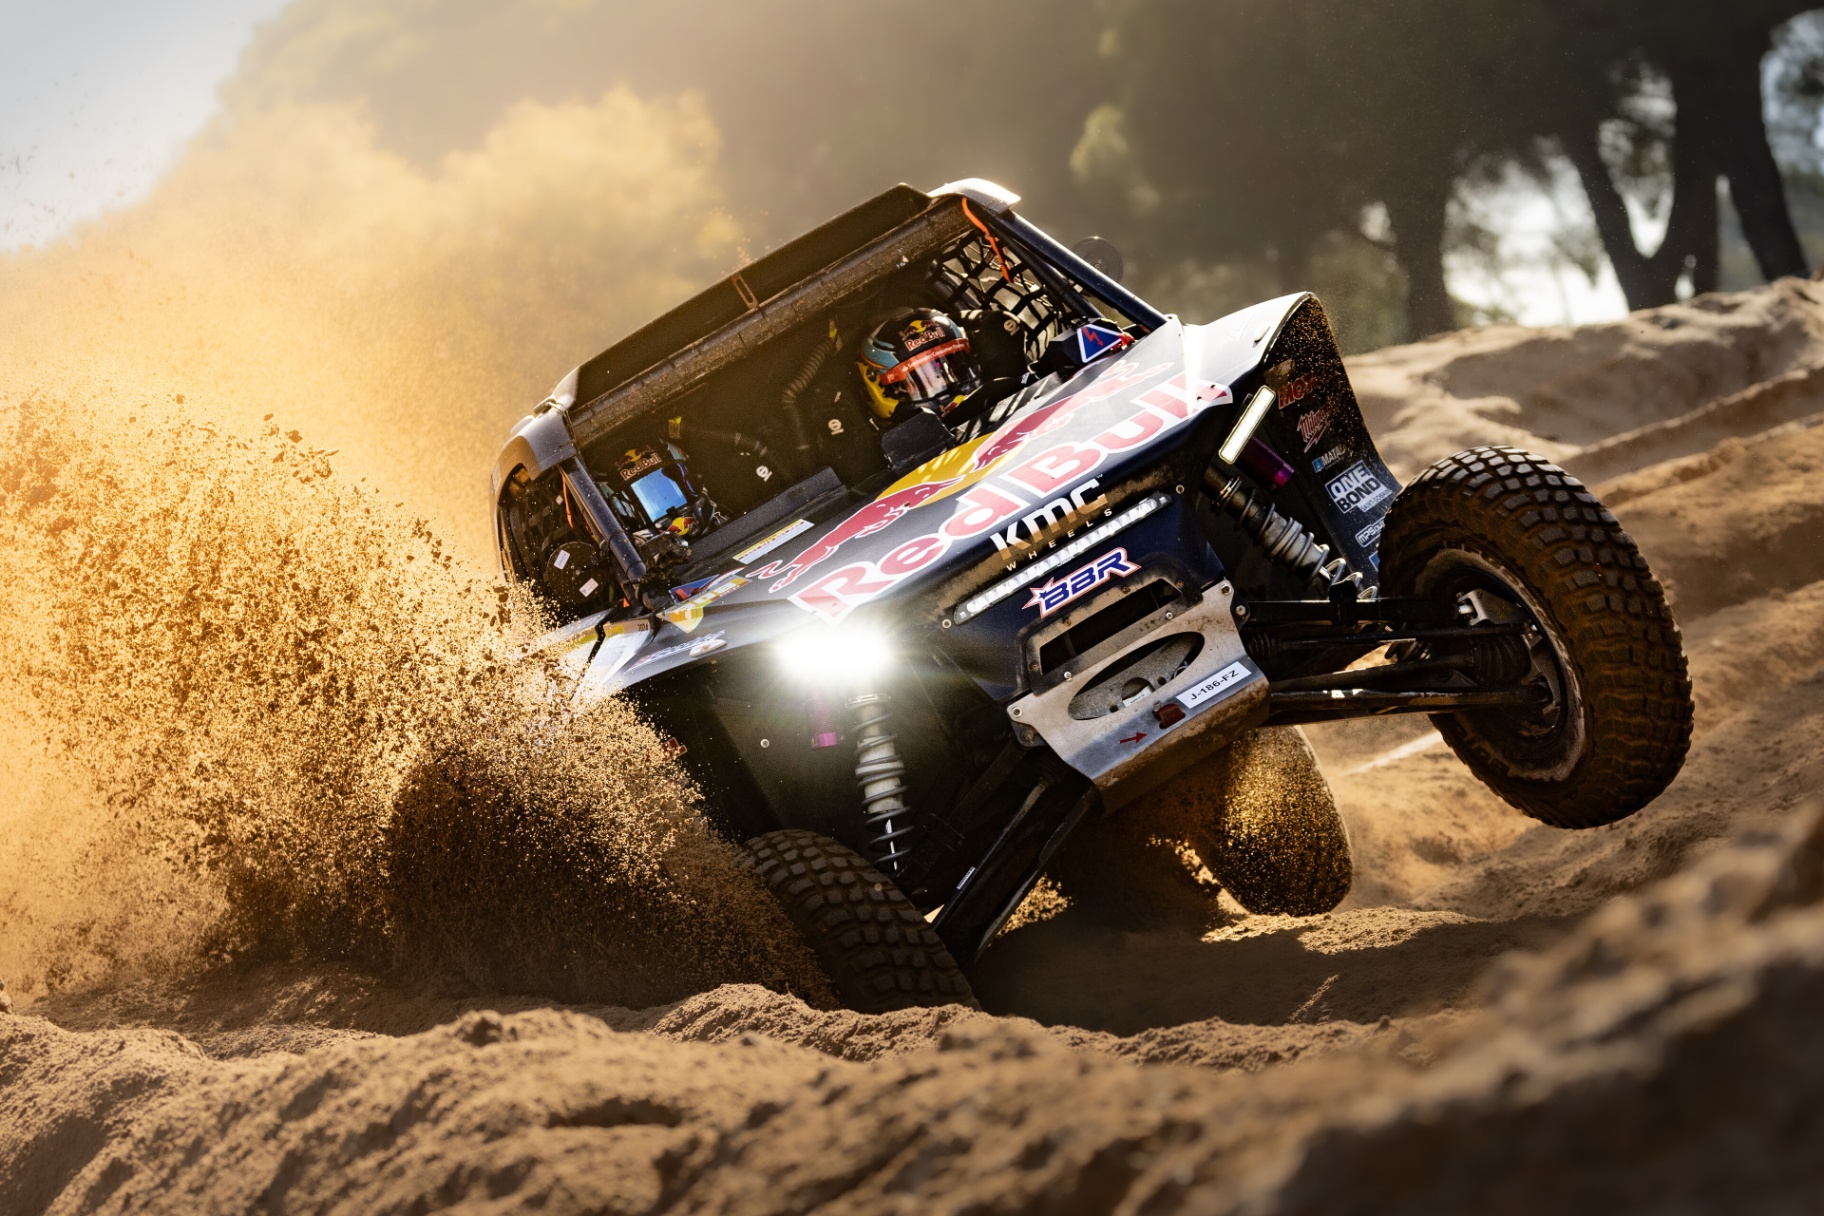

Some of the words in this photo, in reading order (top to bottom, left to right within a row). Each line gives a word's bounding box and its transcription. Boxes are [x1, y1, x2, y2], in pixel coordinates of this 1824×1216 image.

[905, 331, 928, 351] Red
[926, 327, 946, 341] Bull
[620, 462, 642, 480] Red
[640, 453, 662, 470] Bull
[1330, 465, 1371, 498] ONE
[788, 483, 1031, 624] Red
[1000, 370, 1233, 498] Bull
[1336, 477, 1382, 511] BOND
[989, 478, 1109, 561] KMC
[1006, 508, 1113, 572] WHEELS
[1042, 550, 1132, 612] BBR
[1190, 669, 1240, 701] J-186-FZ
